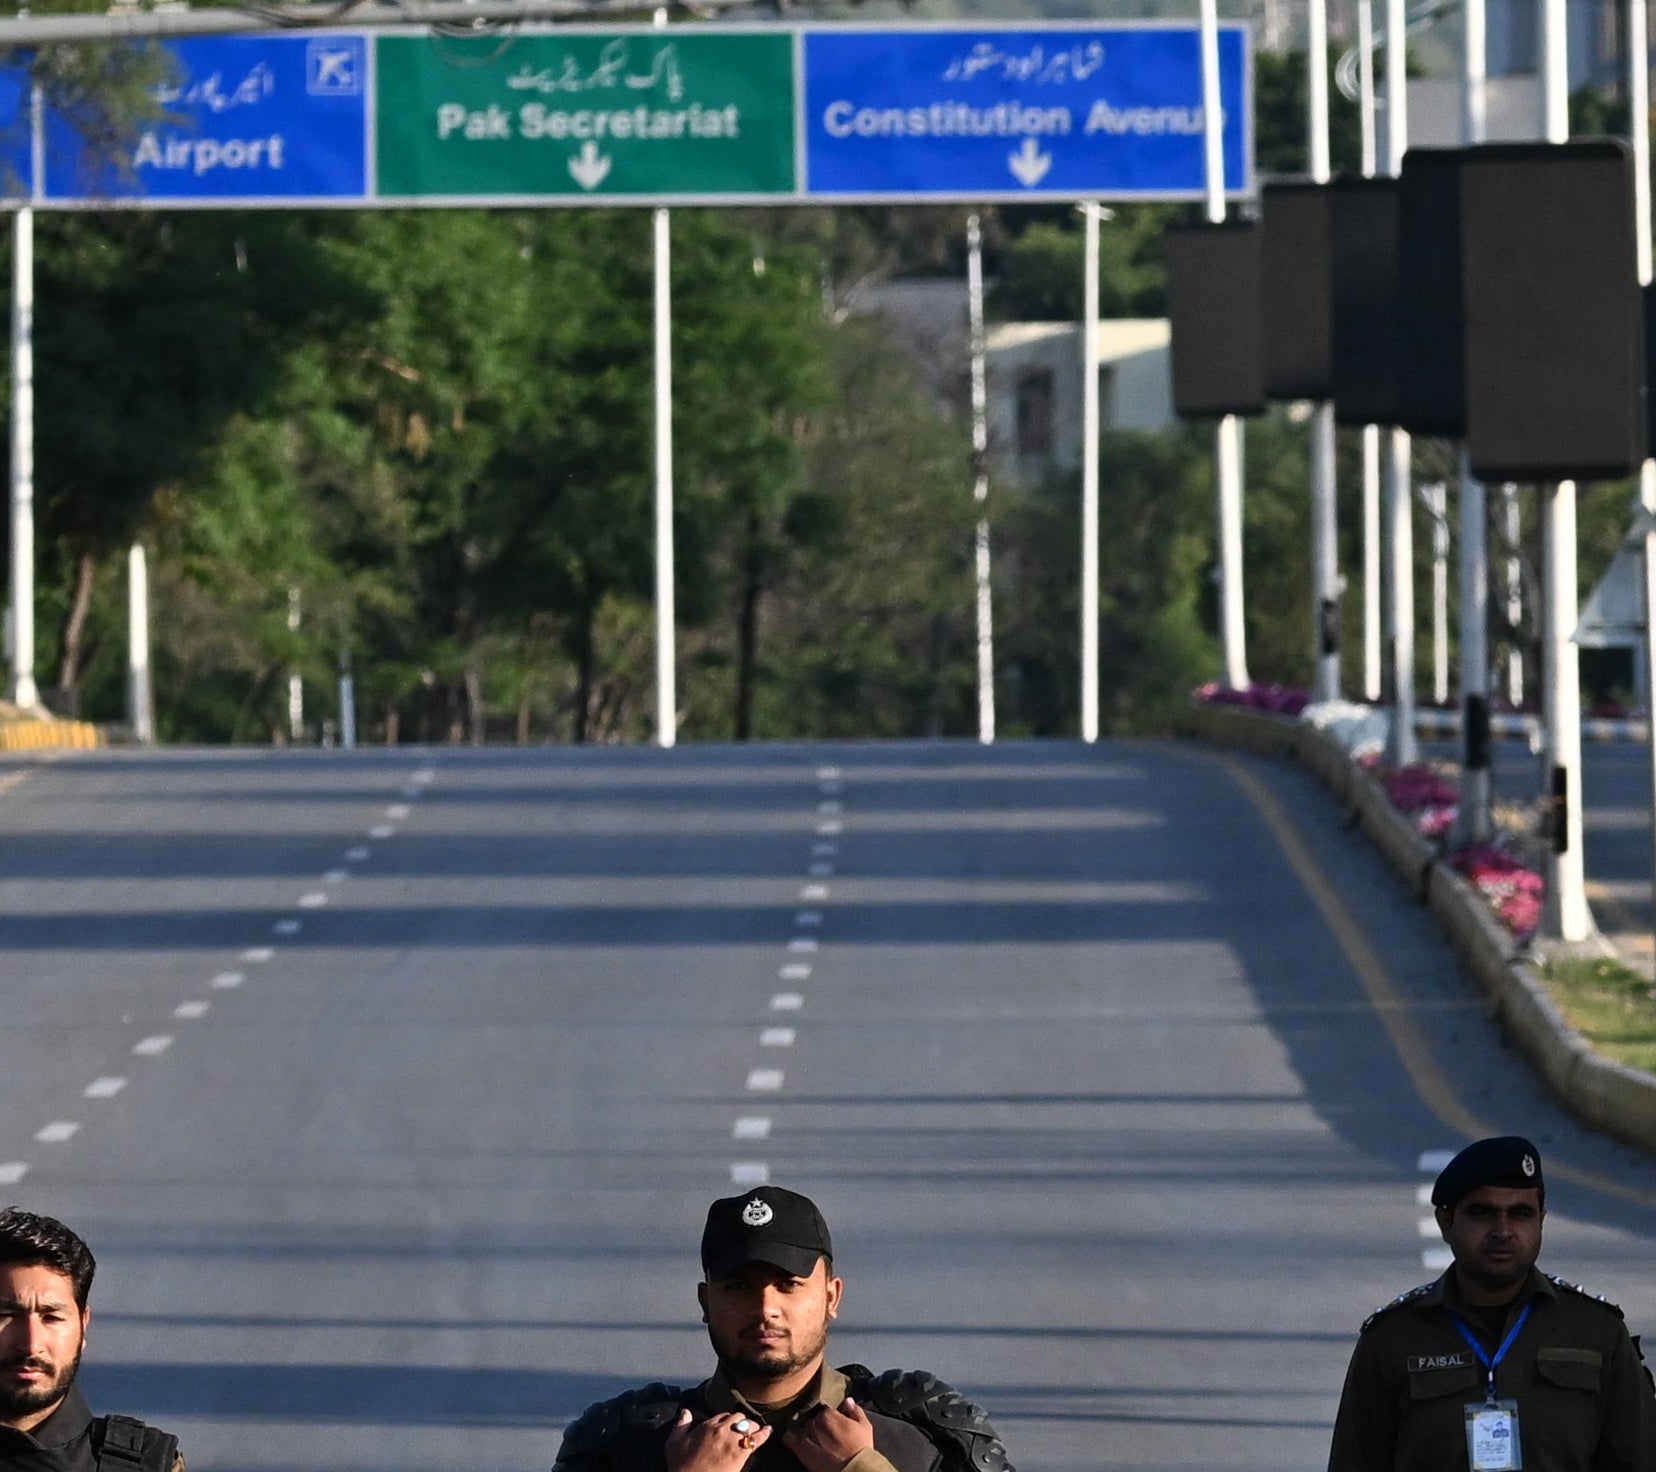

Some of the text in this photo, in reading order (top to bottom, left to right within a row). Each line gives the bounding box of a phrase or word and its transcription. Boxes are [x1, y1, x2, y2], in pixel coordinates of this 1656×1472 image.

[436, 101, 739, 141] Pak Secretariat
[823, 98, 1227, 138] Constitution Avenu
[133, 131, 286, 177] Airport
[1418, 1354, 1465, 1369] FAISAL
